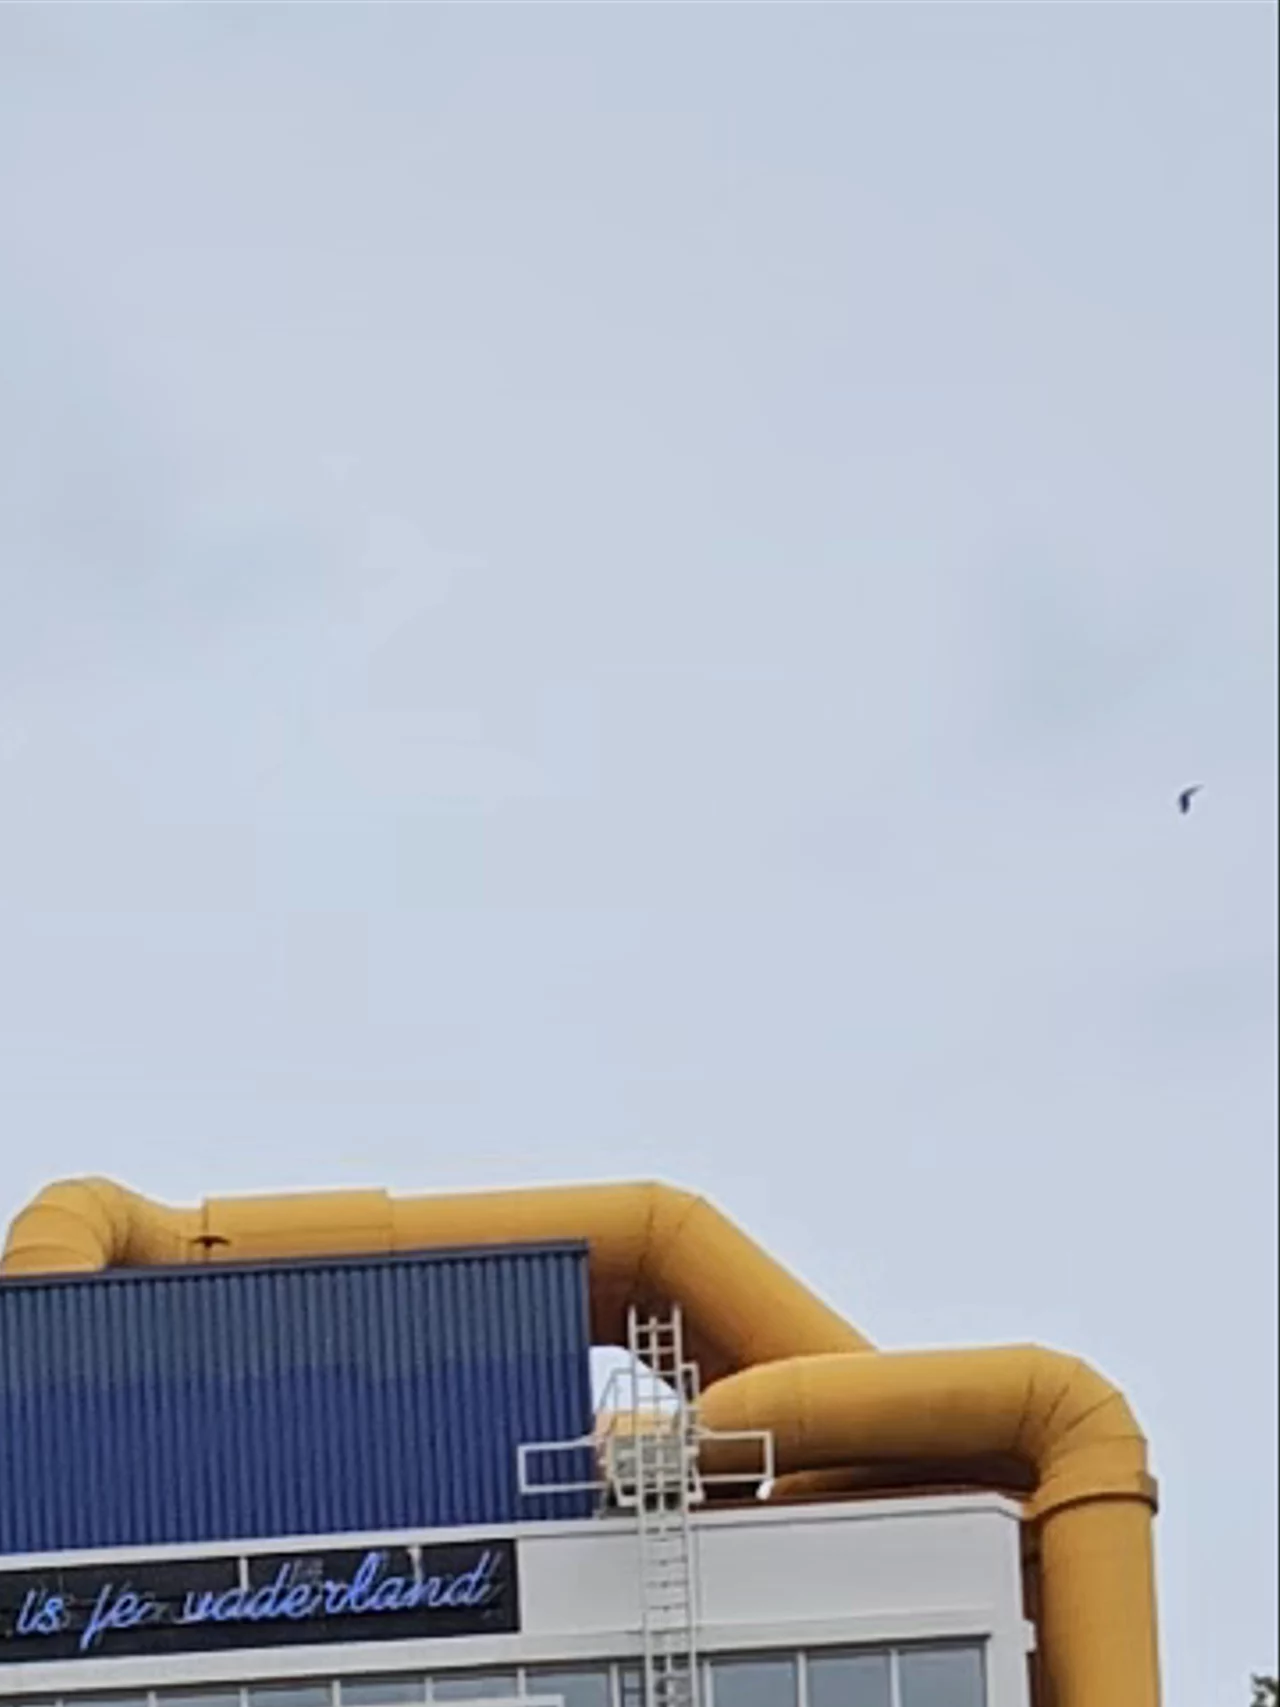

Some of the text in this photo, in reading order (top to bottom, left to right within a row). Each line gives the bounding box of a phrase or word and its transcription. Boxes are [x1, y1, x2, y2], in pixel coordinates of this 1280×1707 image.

[16, 1590, 65, 1634] is
[80, 1583, 145, 1651] je
[175, 1549, 495, 1624] vaderland
